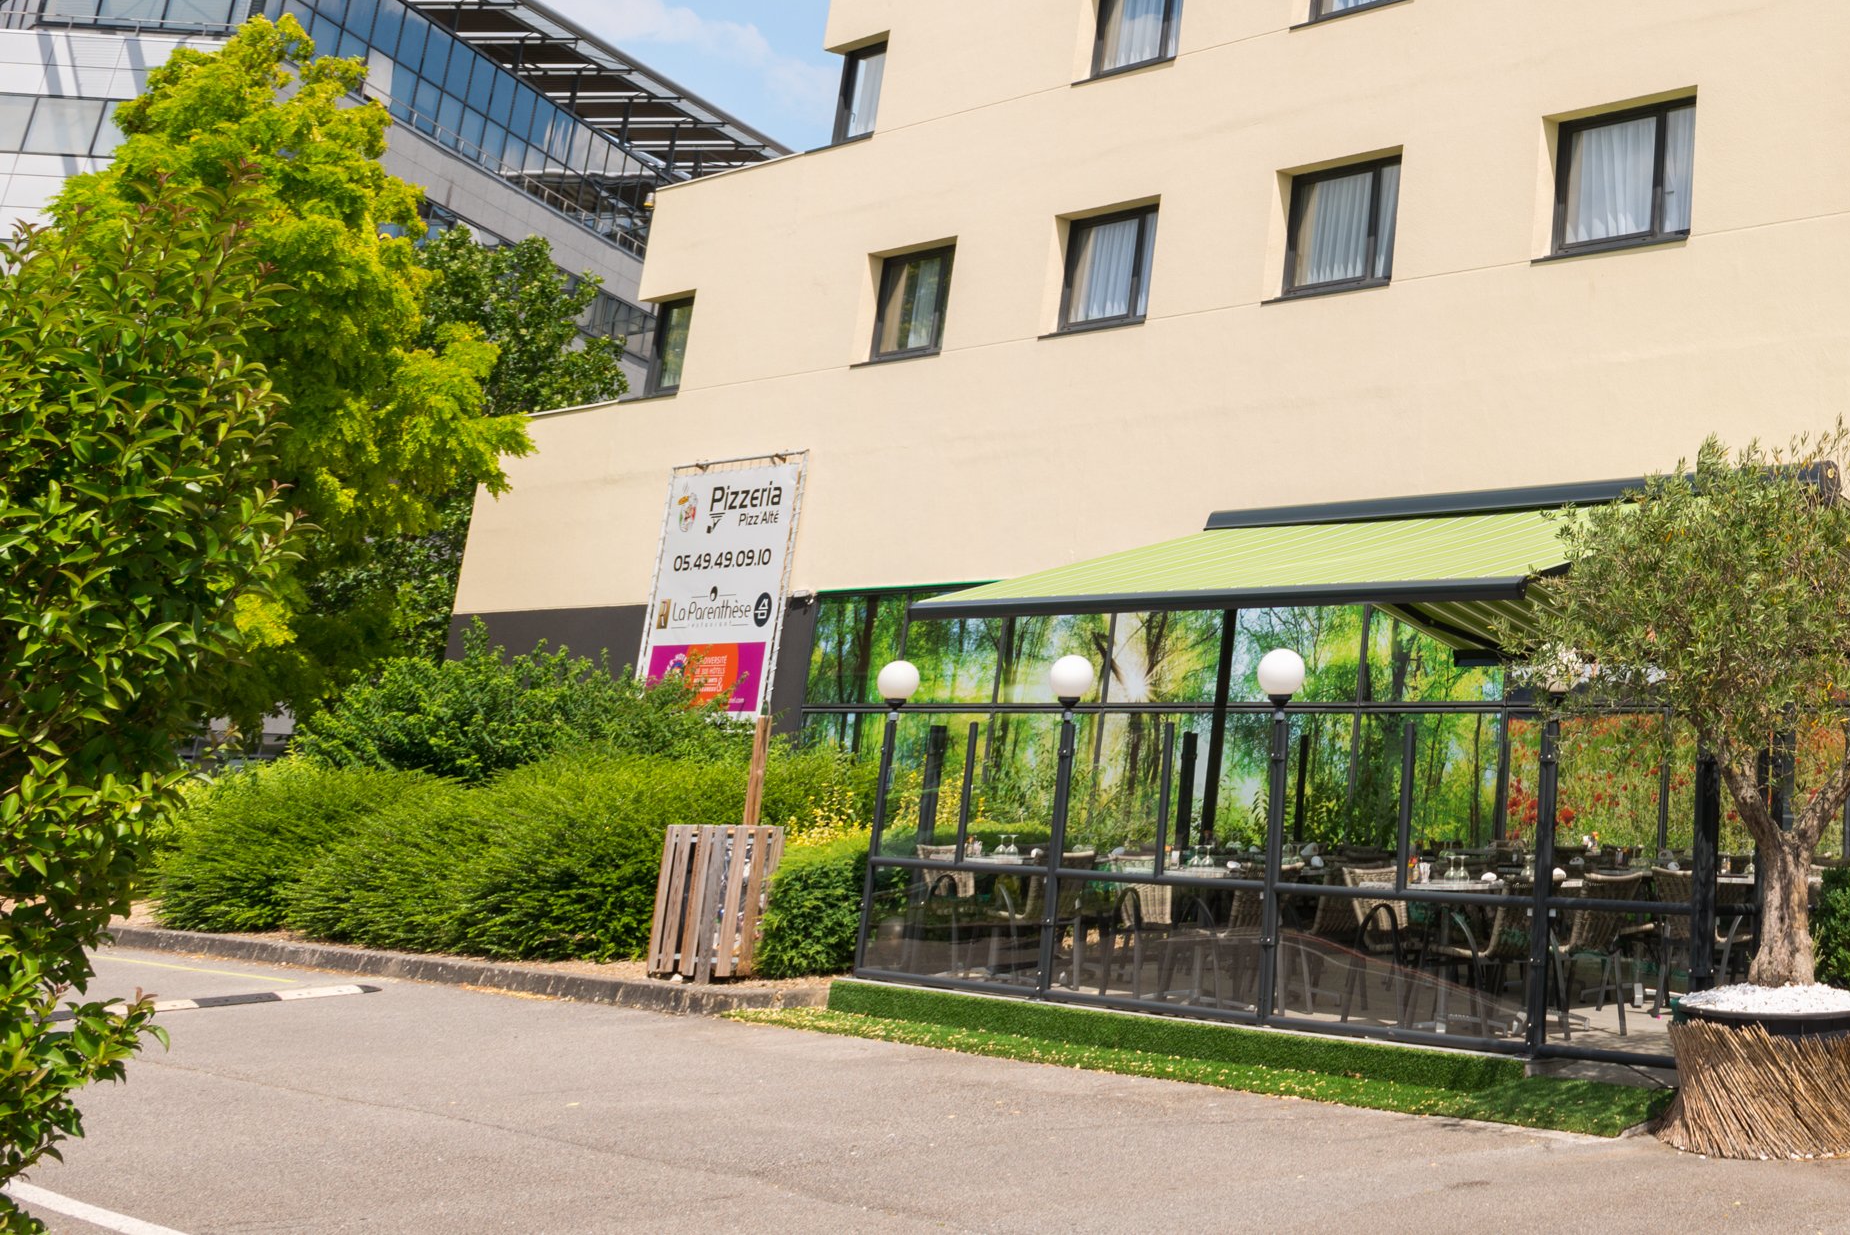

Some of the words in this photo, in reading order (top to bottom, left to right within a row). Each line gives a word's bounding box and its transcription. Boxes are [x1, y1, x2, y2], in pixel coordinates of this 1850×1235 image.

[709, 480, 783, 512] Pizzeria
[673, 548, 772, 572] 05.49.49.09.10
[672, 602, 687, 622] La
[687, 599, 752, 621] Parenthèse
